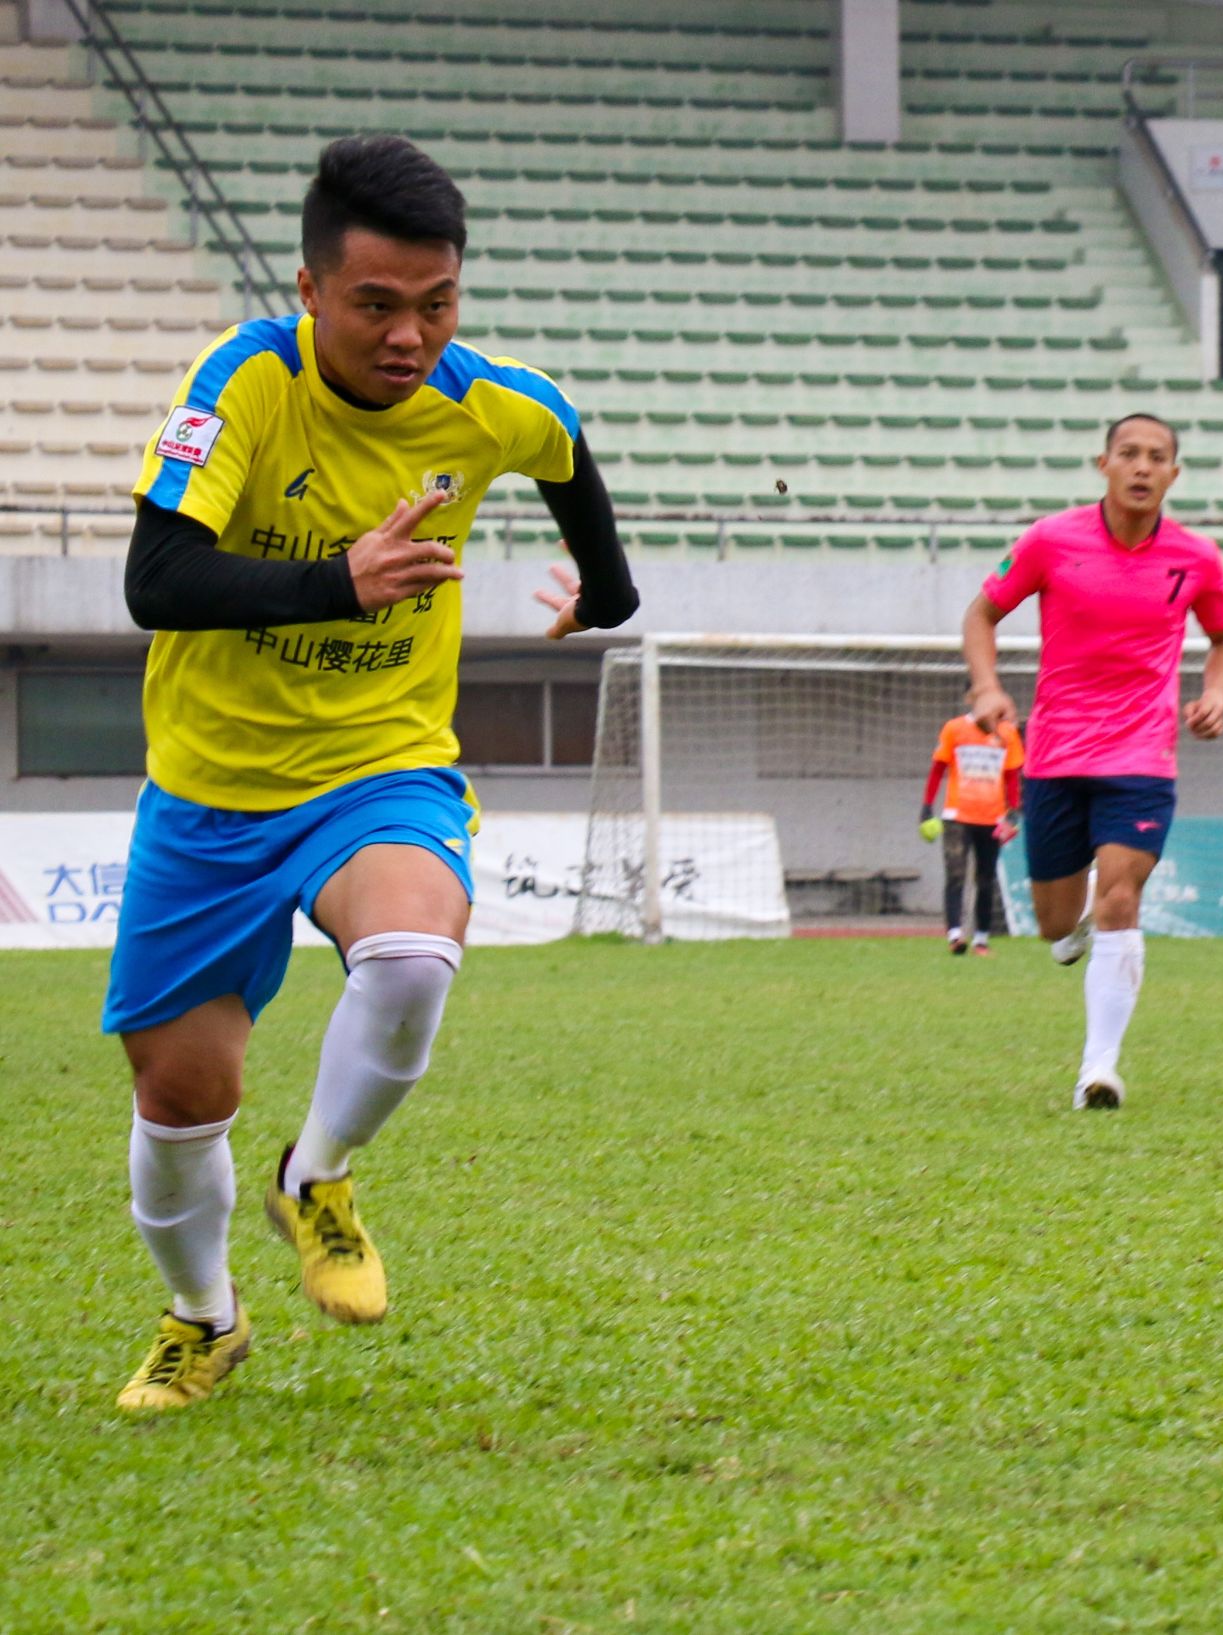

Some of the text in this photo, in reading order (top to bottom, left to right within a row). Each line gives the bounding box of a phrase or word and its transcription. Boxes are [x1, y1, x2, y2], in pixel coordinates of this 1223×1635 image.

[1168, 568, 1188, 605] 7
[245, 625, 414, 673] 中山樱花里
